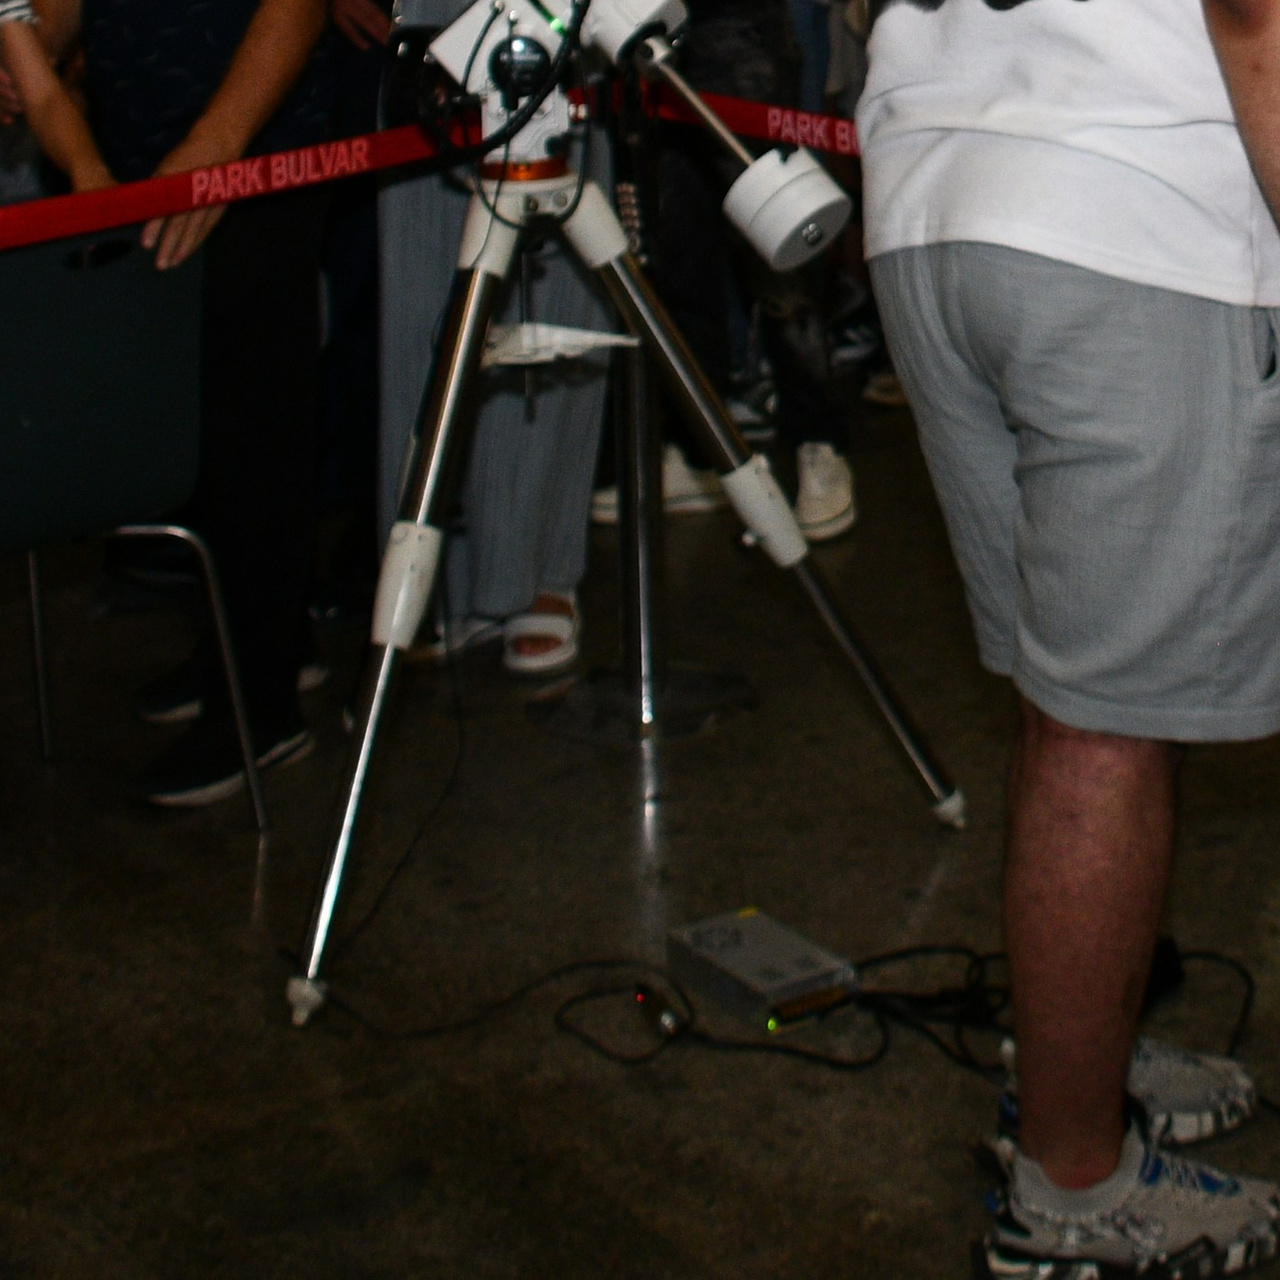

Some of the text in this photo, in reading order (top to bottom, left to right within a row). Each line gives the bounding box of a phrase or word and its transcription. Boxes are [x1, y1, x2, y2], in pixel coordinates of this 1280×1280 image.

[768, 107, 859, 154] PARK B
[192, 137, 369, 205] PARK BULVAR
